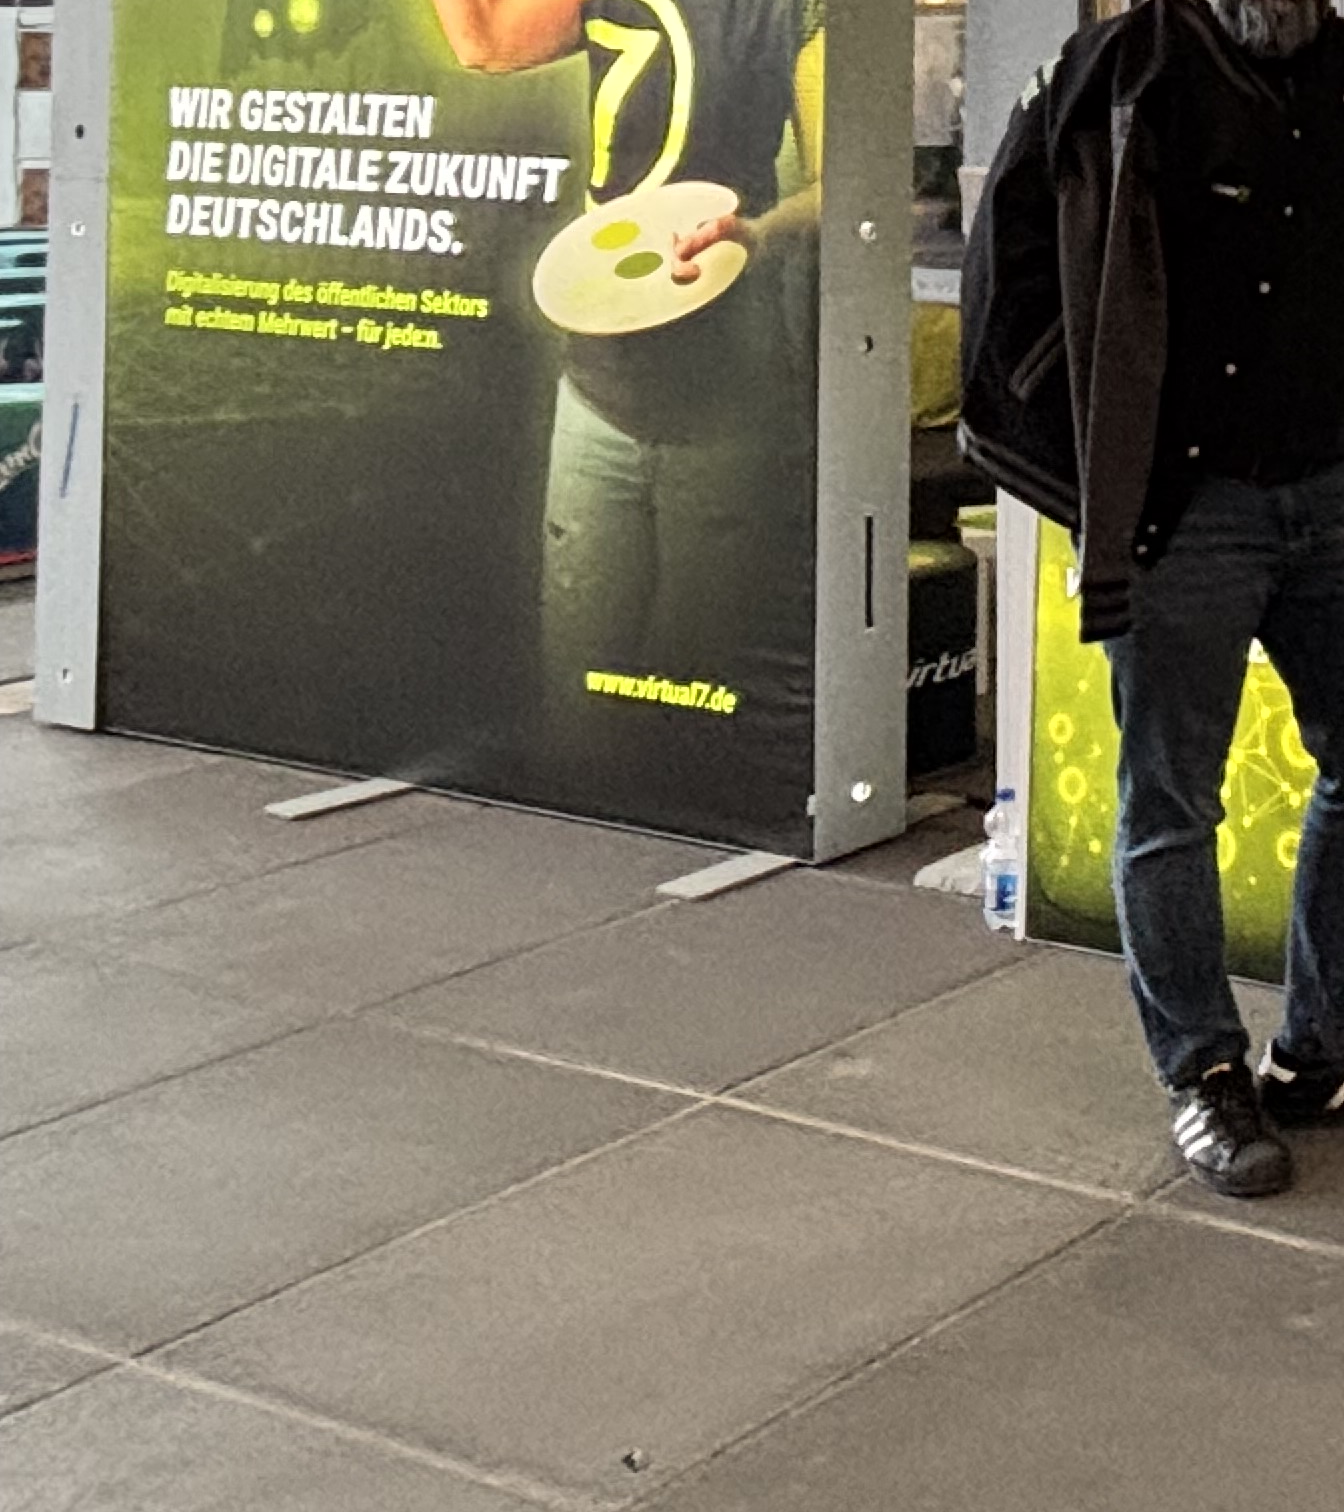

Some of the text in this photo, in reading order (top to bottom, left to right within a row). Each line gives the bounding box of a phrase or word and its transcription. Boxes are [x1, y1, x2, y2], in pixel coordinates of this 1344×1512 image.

[169, 86, 437, 139] WIR GESTALTEN
[166, 141, 570, 203] DIE DIGITALE ZUKUNFT
[166, 194, 466, 255] DEUTSCHLANDS.
[282, 279, 314, 303] des
[420, 288, 489, 318] Sektors
[256, 311, 338, 340] Mehrwert
[356, 318, 384, 343] für
[586, 670, 737, 714] www.virtual7.de
